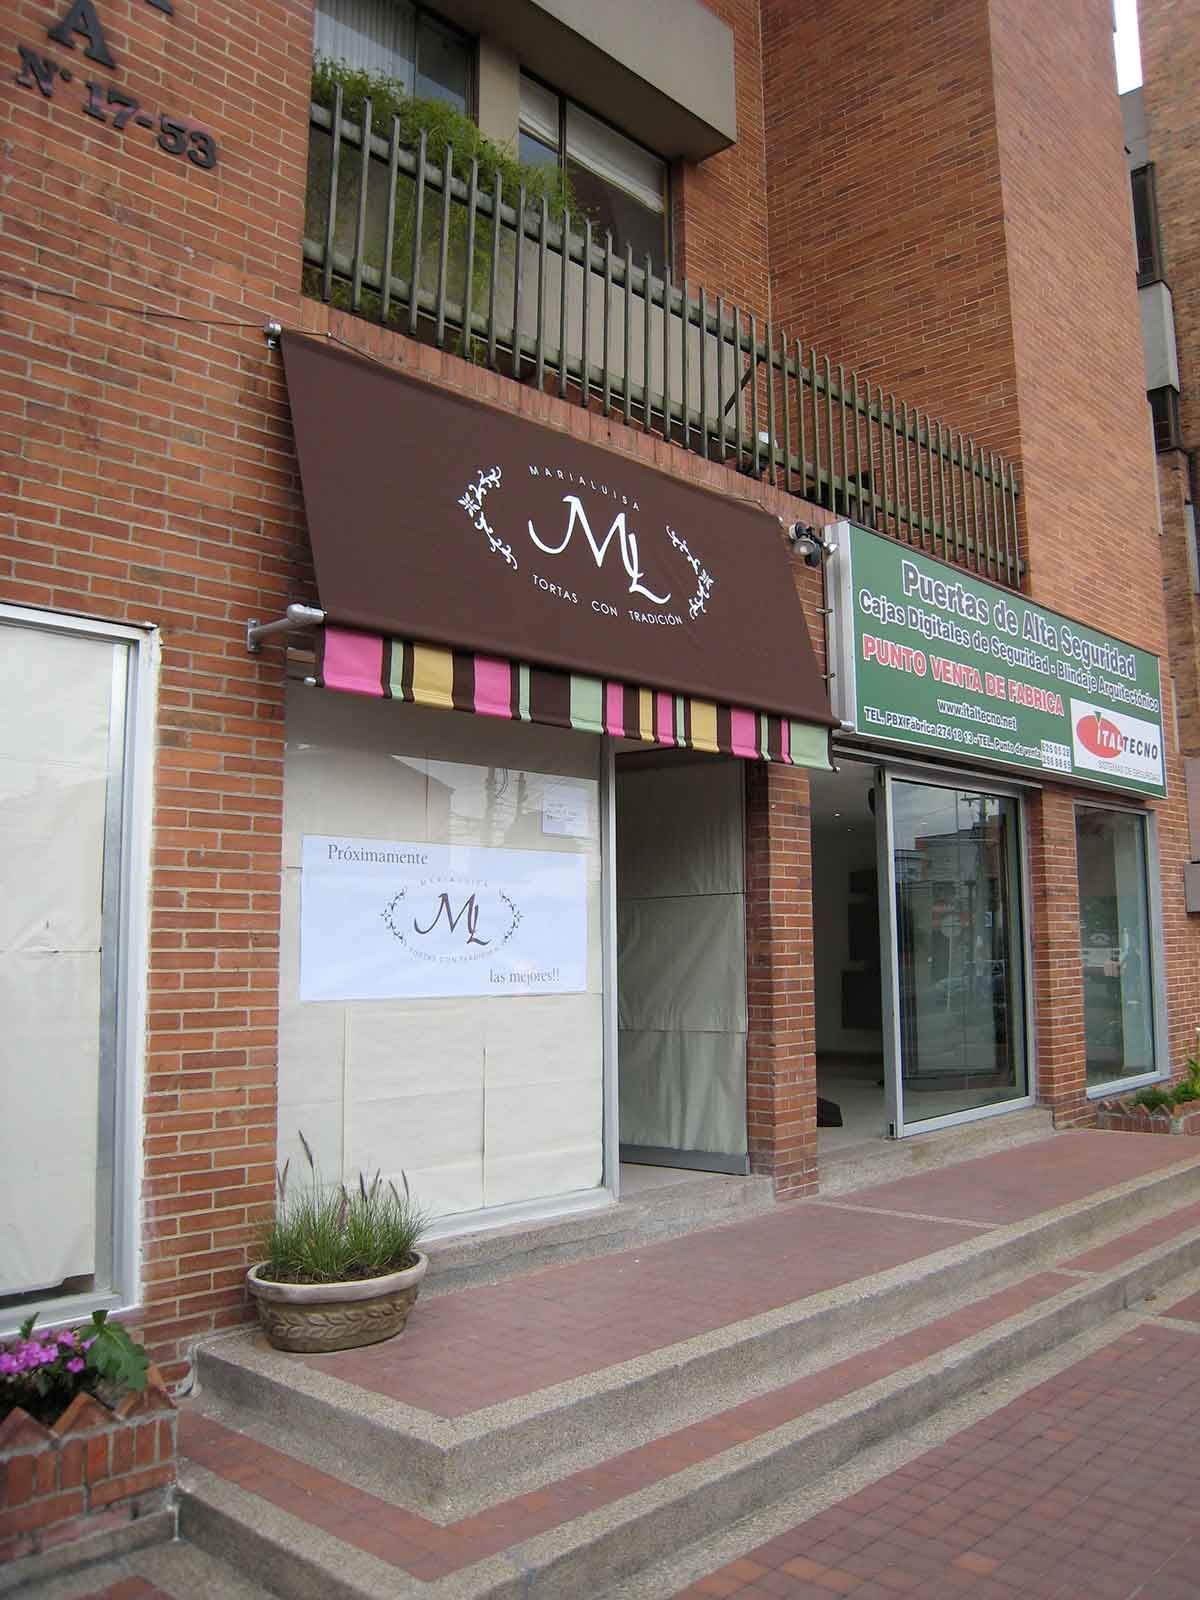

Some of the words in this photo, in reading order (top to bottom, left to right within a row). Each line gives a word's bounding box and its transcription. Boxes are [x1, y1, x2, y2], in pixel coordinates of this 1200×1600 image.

[83, 79, 217, 170] 17-53
[528, 465, 641, 512] MARIALUISA
[532, 574, 578, 604] TORTAS
[591, 600, 618, 617] CON
[628, 610, 683, 626] TRADICIÓN
[902, 560, 989, 625] Puertas
[994, 600, 1018, 636] de
[1022, 610, 1058, 651] Alta
[1061, 625, 1136, 681] Seguridad
[859, 589, 905, 625] Cajas
[908, 606, 970, 649] Digitales
[972, 630, 990, 654] de
[991, 635, 1050, 675] Seguridad
[1056, 660, 1097, 694] Blindaje
[1099, 676, 1160, 713] Arquitectónico
[862, 633, 927, 677] PUNTO
[930, 654, 983, 694] VENTA
[985, 672, 1006, 700] DE
[1007, 678, 1065, 717] FABRICA
[864, 706, 885, 725] TEL.
[937, 699, 1017, 731] www.italtecno.net
[328, 844, 429, 865] Próximamente
[489, 967, 505, 983] las
[510, 967, 560, 985] mejores!!
